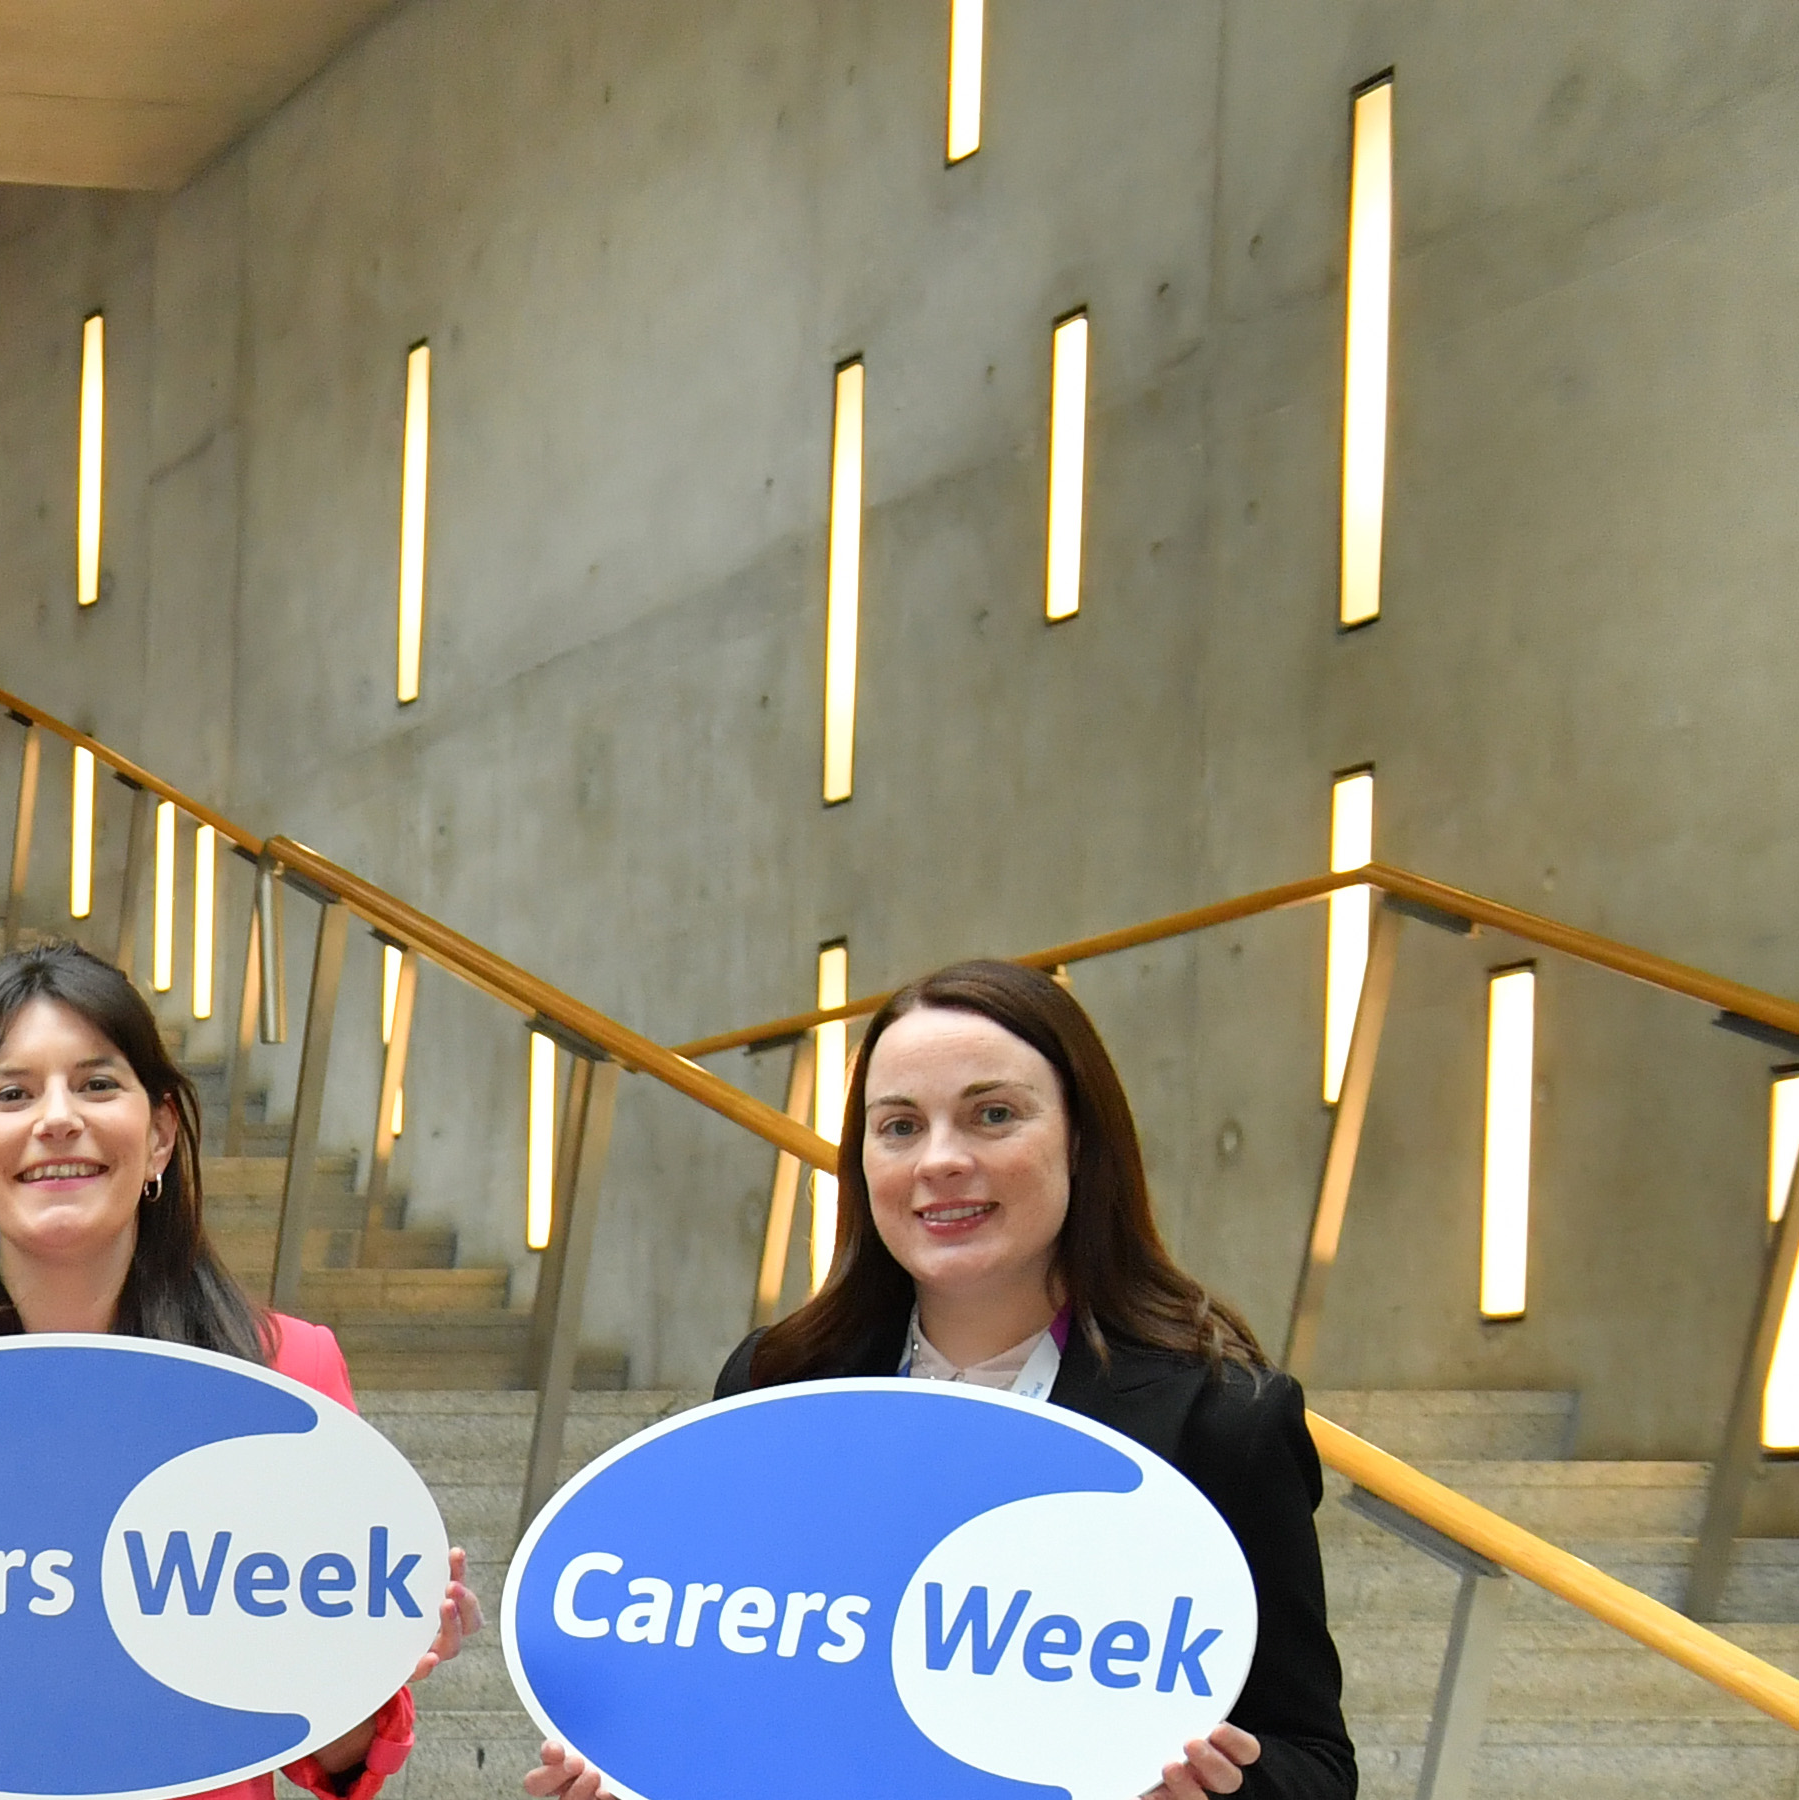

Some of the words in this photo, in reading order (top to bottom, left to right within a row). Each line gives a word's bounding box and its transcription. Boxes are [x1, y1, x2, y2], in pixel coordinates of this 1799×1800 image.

[123, 1526, 423, 1617] Week
[552, 1552, 871, 1664] Carers
[923, 1582, 1223, 1697] Week
